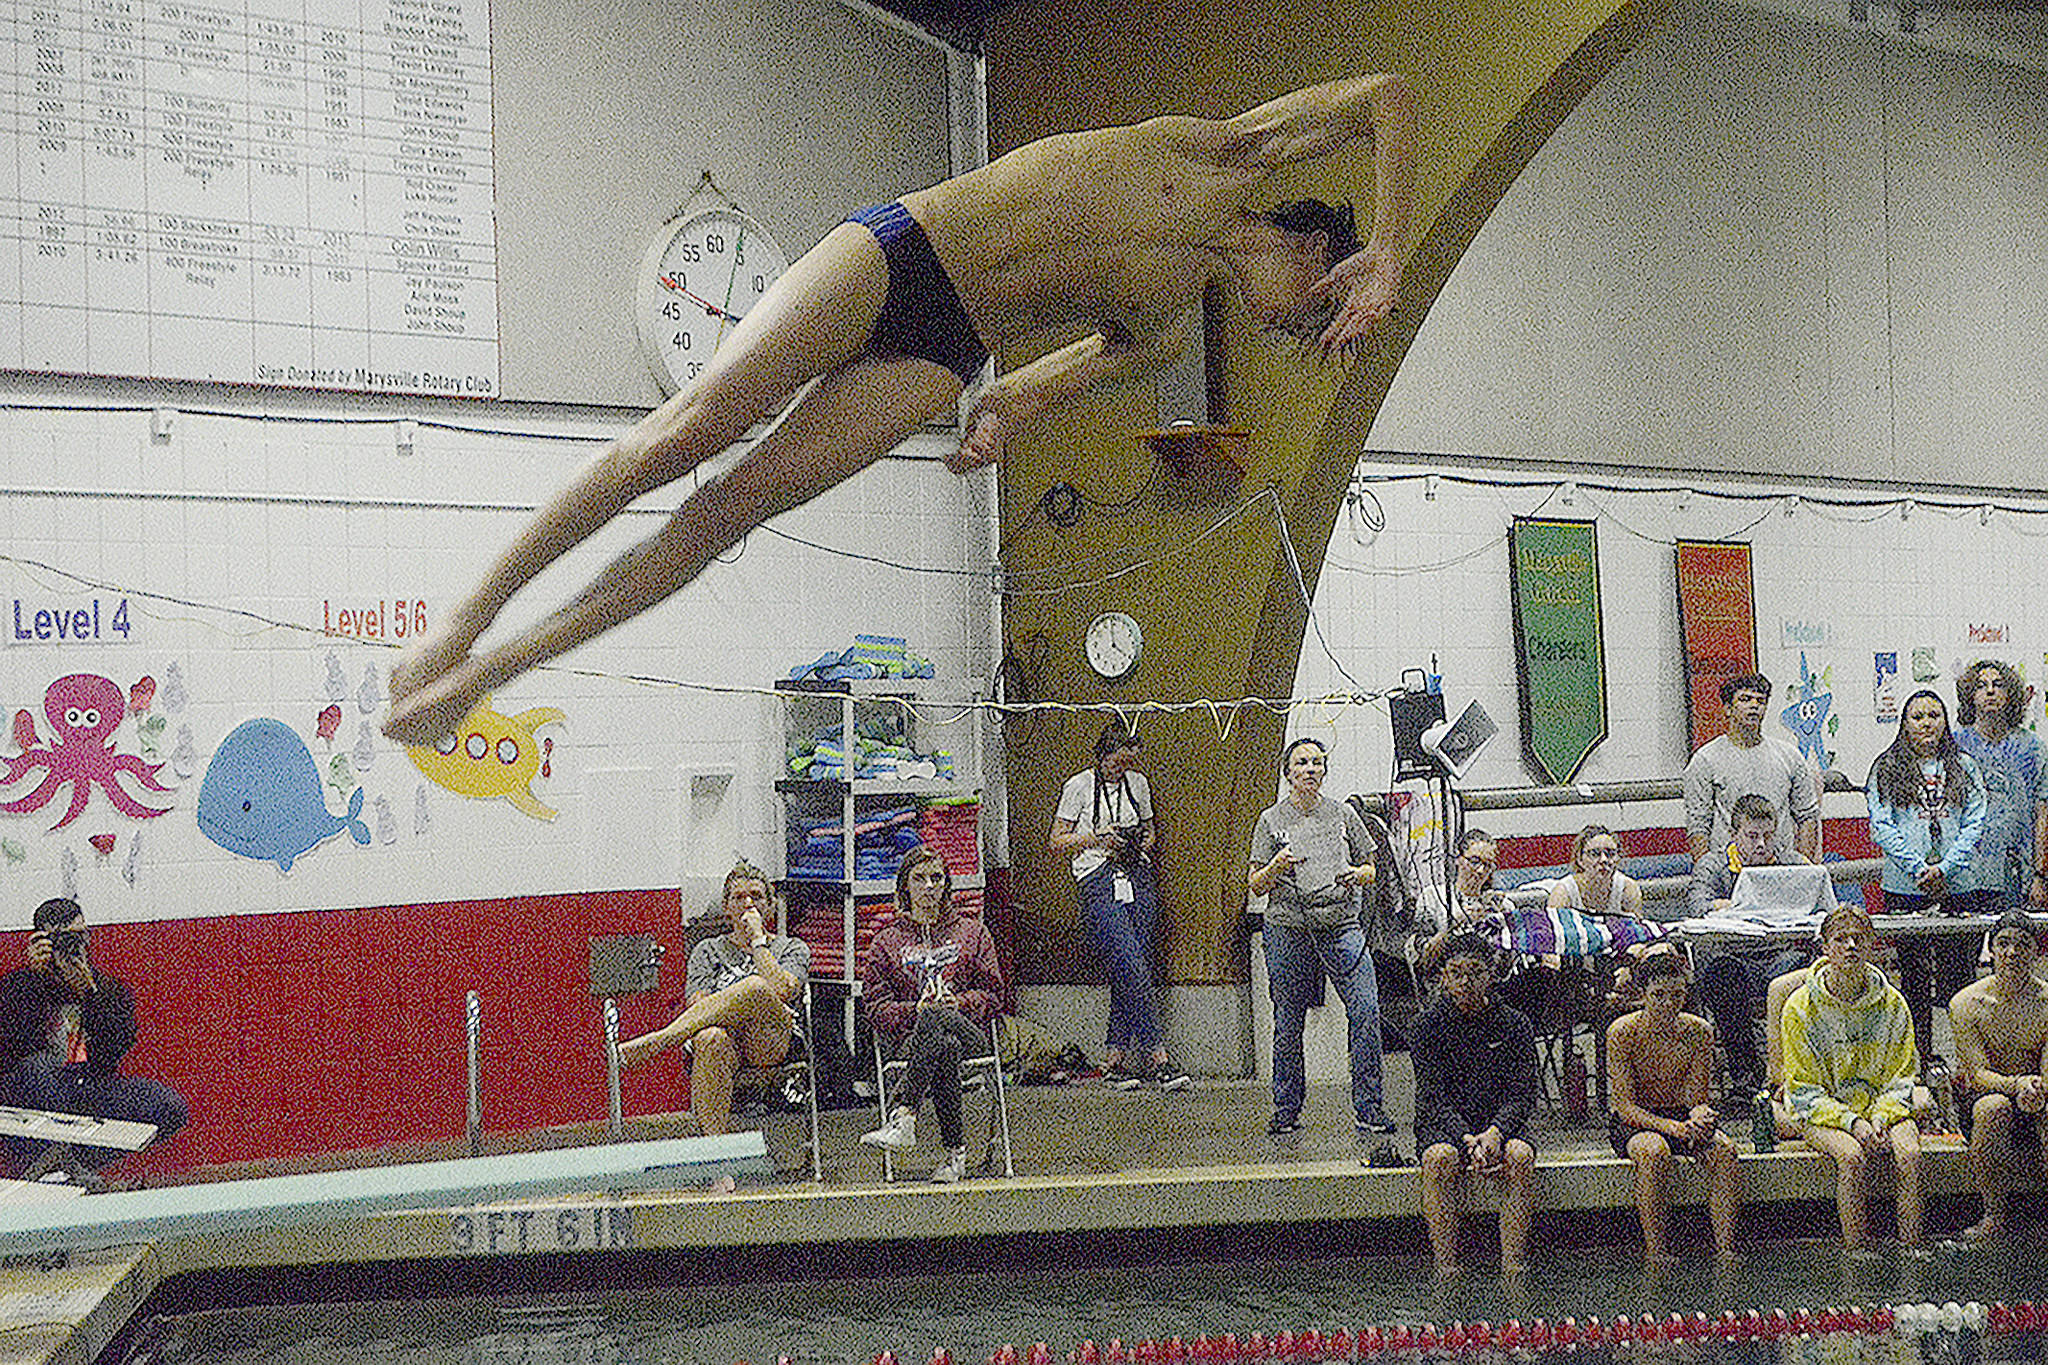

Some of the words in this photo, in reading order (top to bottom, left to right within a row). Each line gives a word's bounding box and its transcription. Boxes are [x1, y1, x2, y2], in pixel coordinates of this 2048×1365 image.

[682, 243, 701, 263] 55
[705, 234, 725, 254] 60
[752, 275, 764, 293] 10
[662, 302, 681, 321] 45
[672, 332, 691, 350] 40
[257, 364, 285, 383] Sign
[287, 365, 335, 383] Donated
[354, 368, 419, 389] Marysville
[421, 371, 463, 393] Rotary
[464, 375, 493, 393] Club
[13, 599, 100, 639] Level
[112, 599, 131, 639] 4
[323, 599, 385, 638] Level
[394, 599, 427, 638] 5/6
[556, 1208, 581, 1247] 6
[593, 1206, 633, 1248] IN
